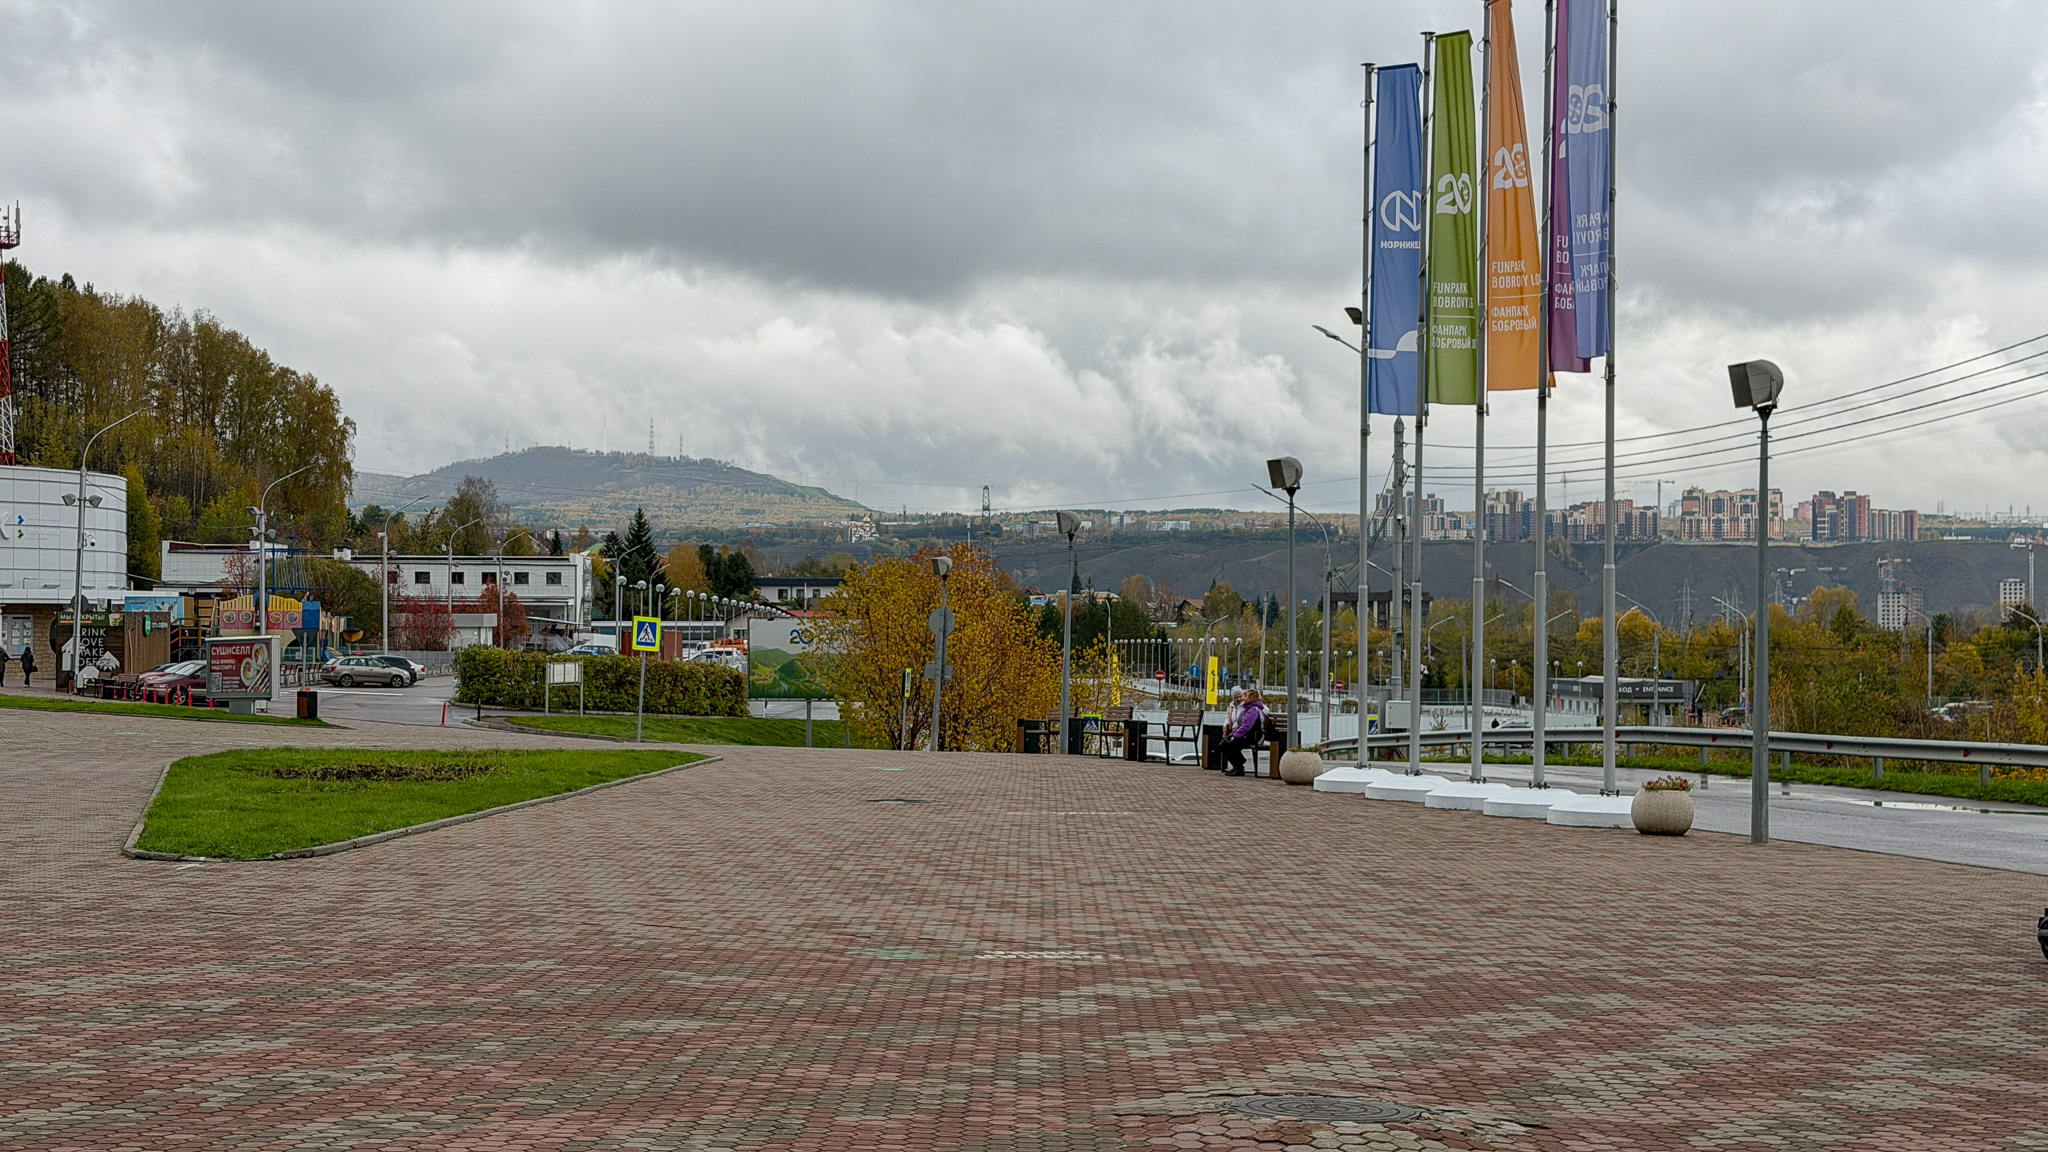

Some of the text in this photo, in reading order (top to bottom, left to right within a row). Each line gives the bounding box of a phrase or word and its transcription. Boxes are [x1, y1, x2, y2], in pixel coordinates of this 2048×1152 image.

[1436, 173, 1472, 215] 20
[1380, 240, 1420, 249] НОРНИКЕ
[1531, 273, 1541, 285] LO
[1433, 282, 1468, 294] FUNPARK
[1492, 317, 1537, 332] БОБРОВЫЙ
[81, 628, 107, 637] RINK
[81, 637, 104, 647] OVE
[211, 646, 250, 655] СУШИСЕЛЛ
[79, 658, 111, 666] OFFEE
